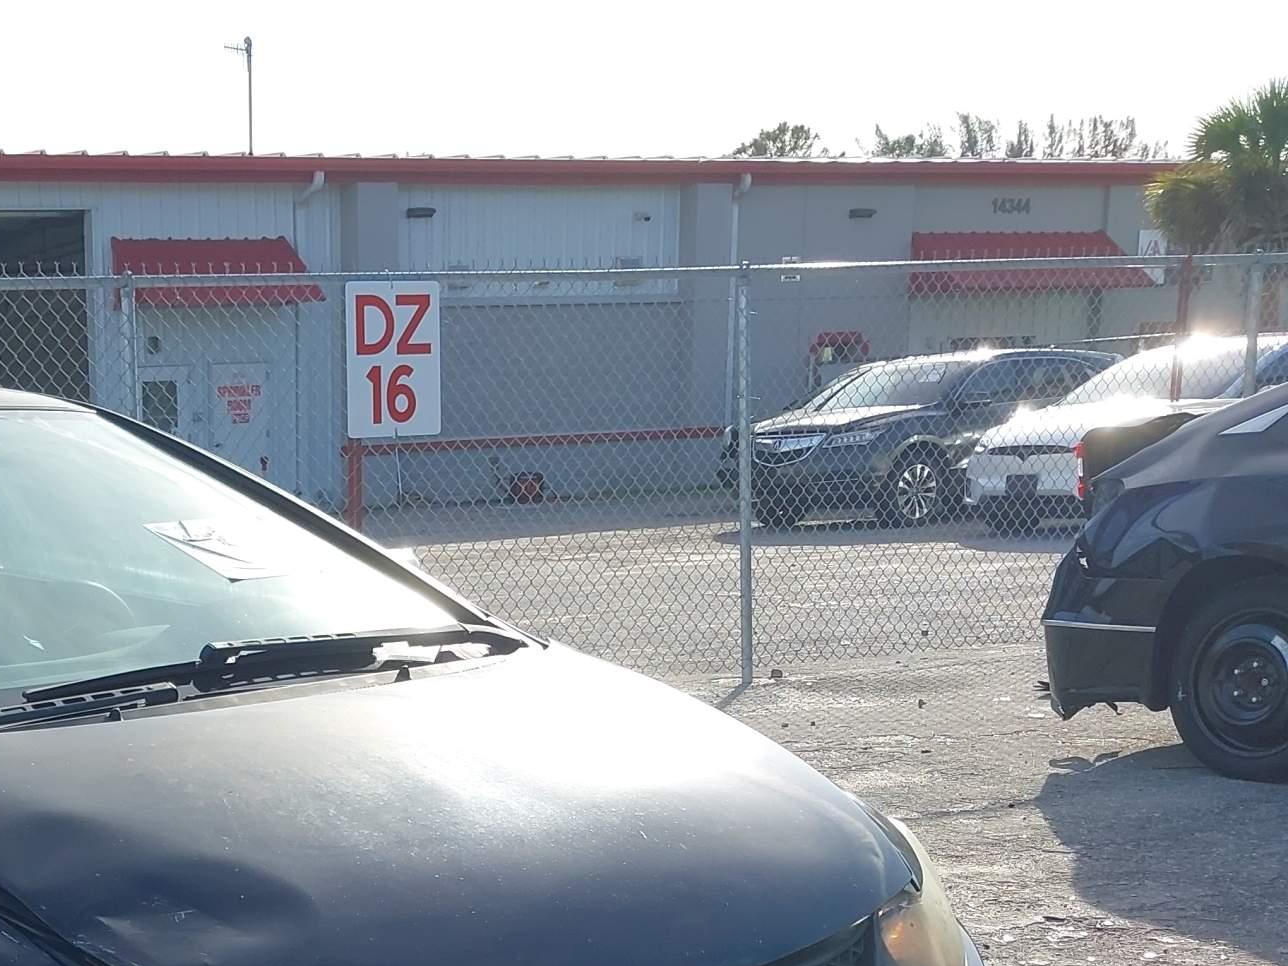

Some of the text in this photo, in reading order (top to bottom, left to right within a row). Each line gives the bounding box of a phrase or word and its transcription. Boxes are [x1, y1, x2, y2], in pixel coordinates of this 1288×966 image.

[991, 197, 1032, 215] 14344
[355, 294, 432, 355] DZ
[366, 364, 416, 424] 16
